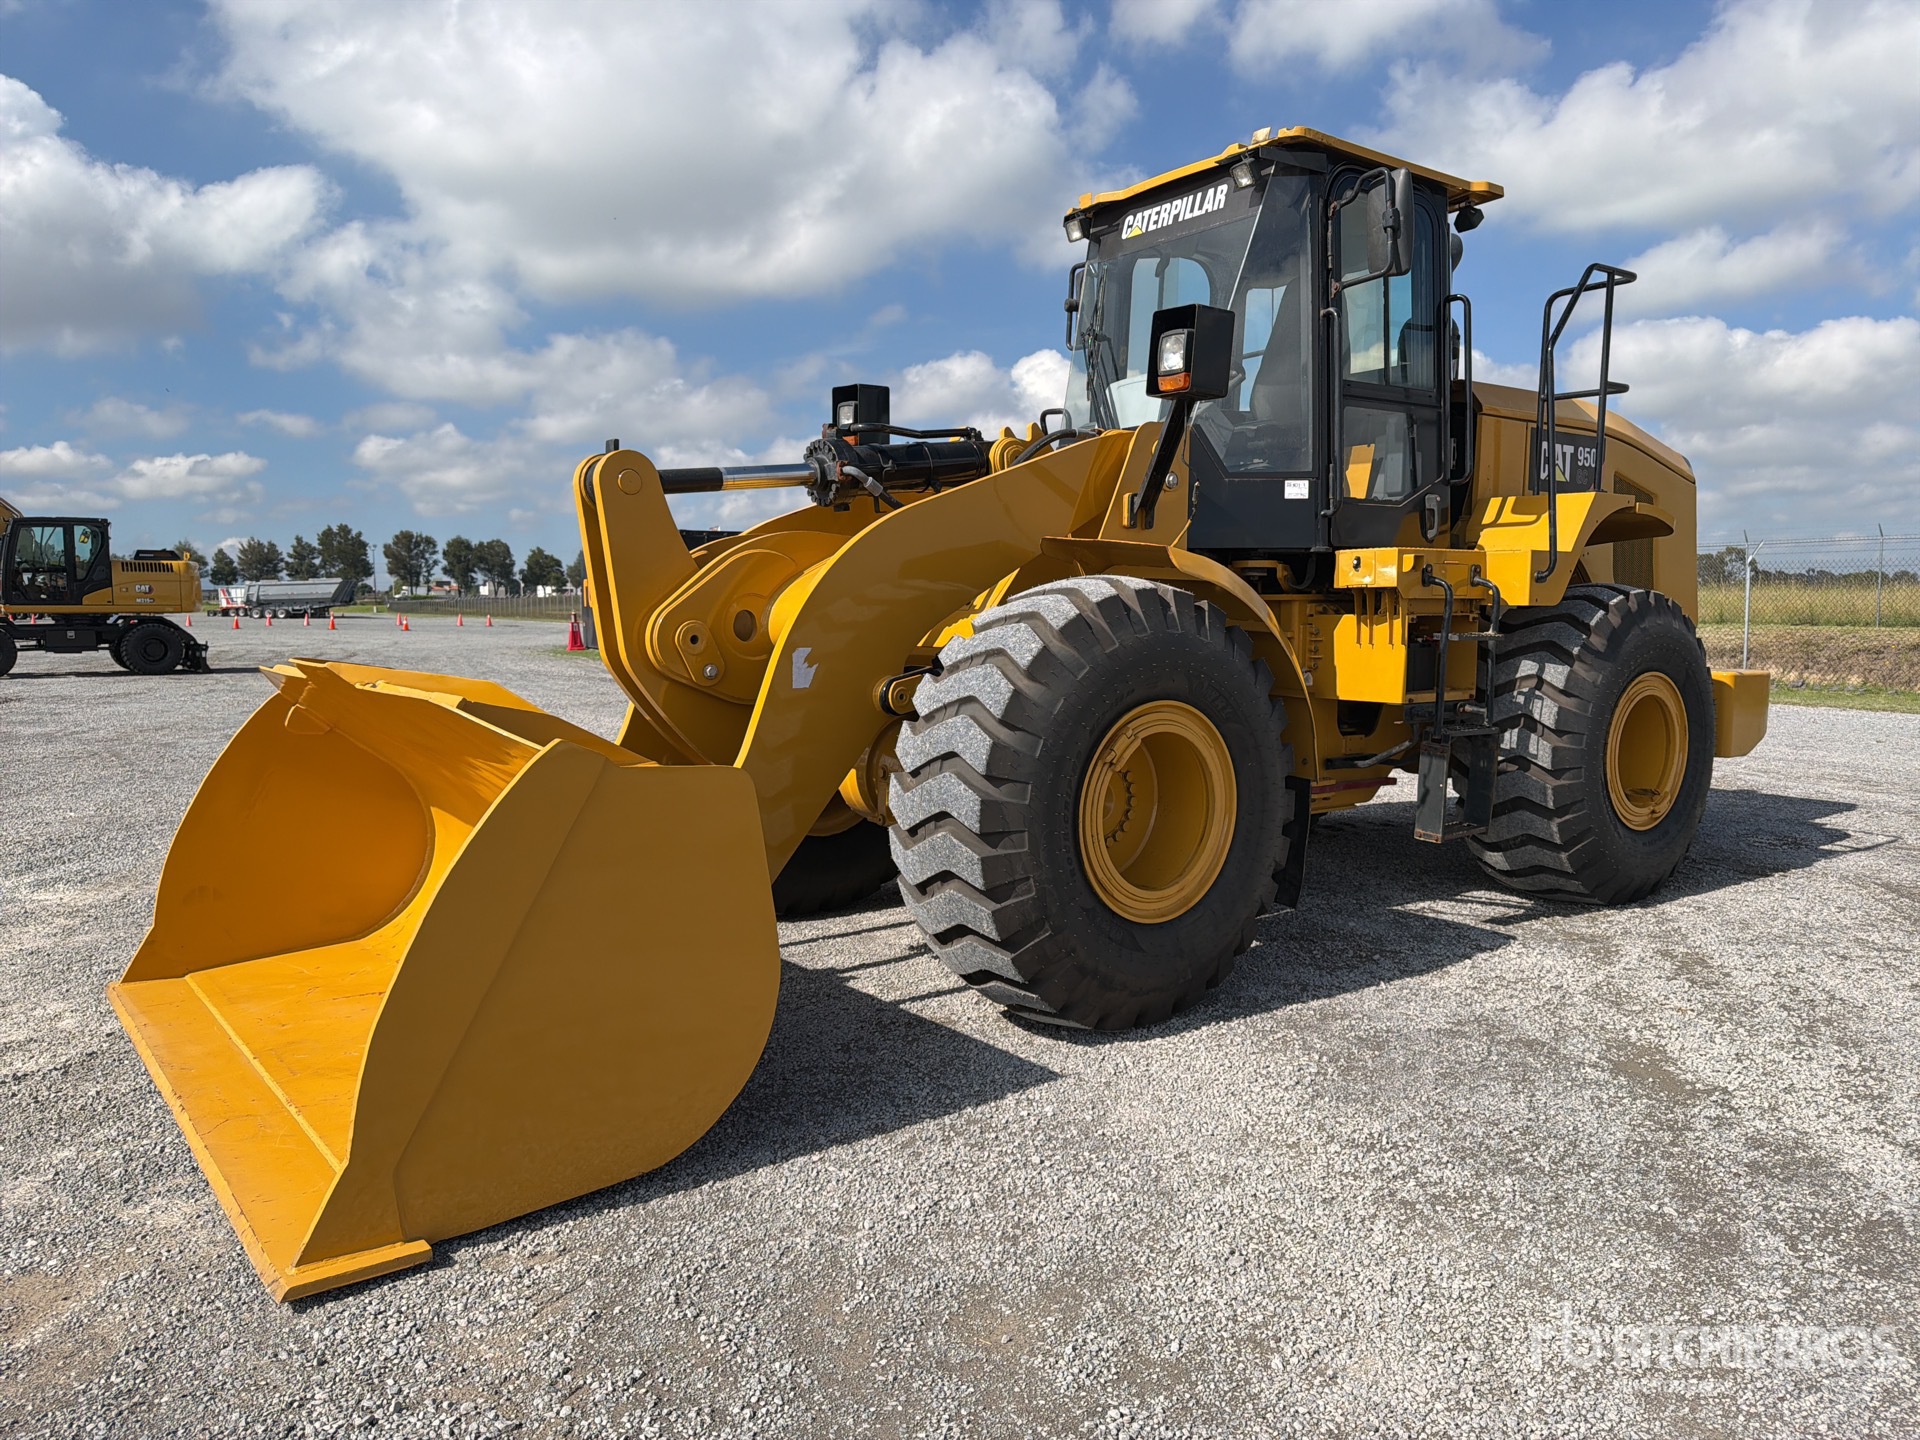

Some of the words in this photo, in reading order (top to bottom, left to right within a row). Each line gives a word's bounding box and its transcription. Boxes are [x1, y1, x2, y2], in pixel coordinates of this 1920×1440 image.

[1121, 183, 1228, 240] CATERPILLAR
[1540, 441, 1574, 482] CAT
[1577, 446, 1597, 468] 950
[135, 584, 150, 593] CAT
